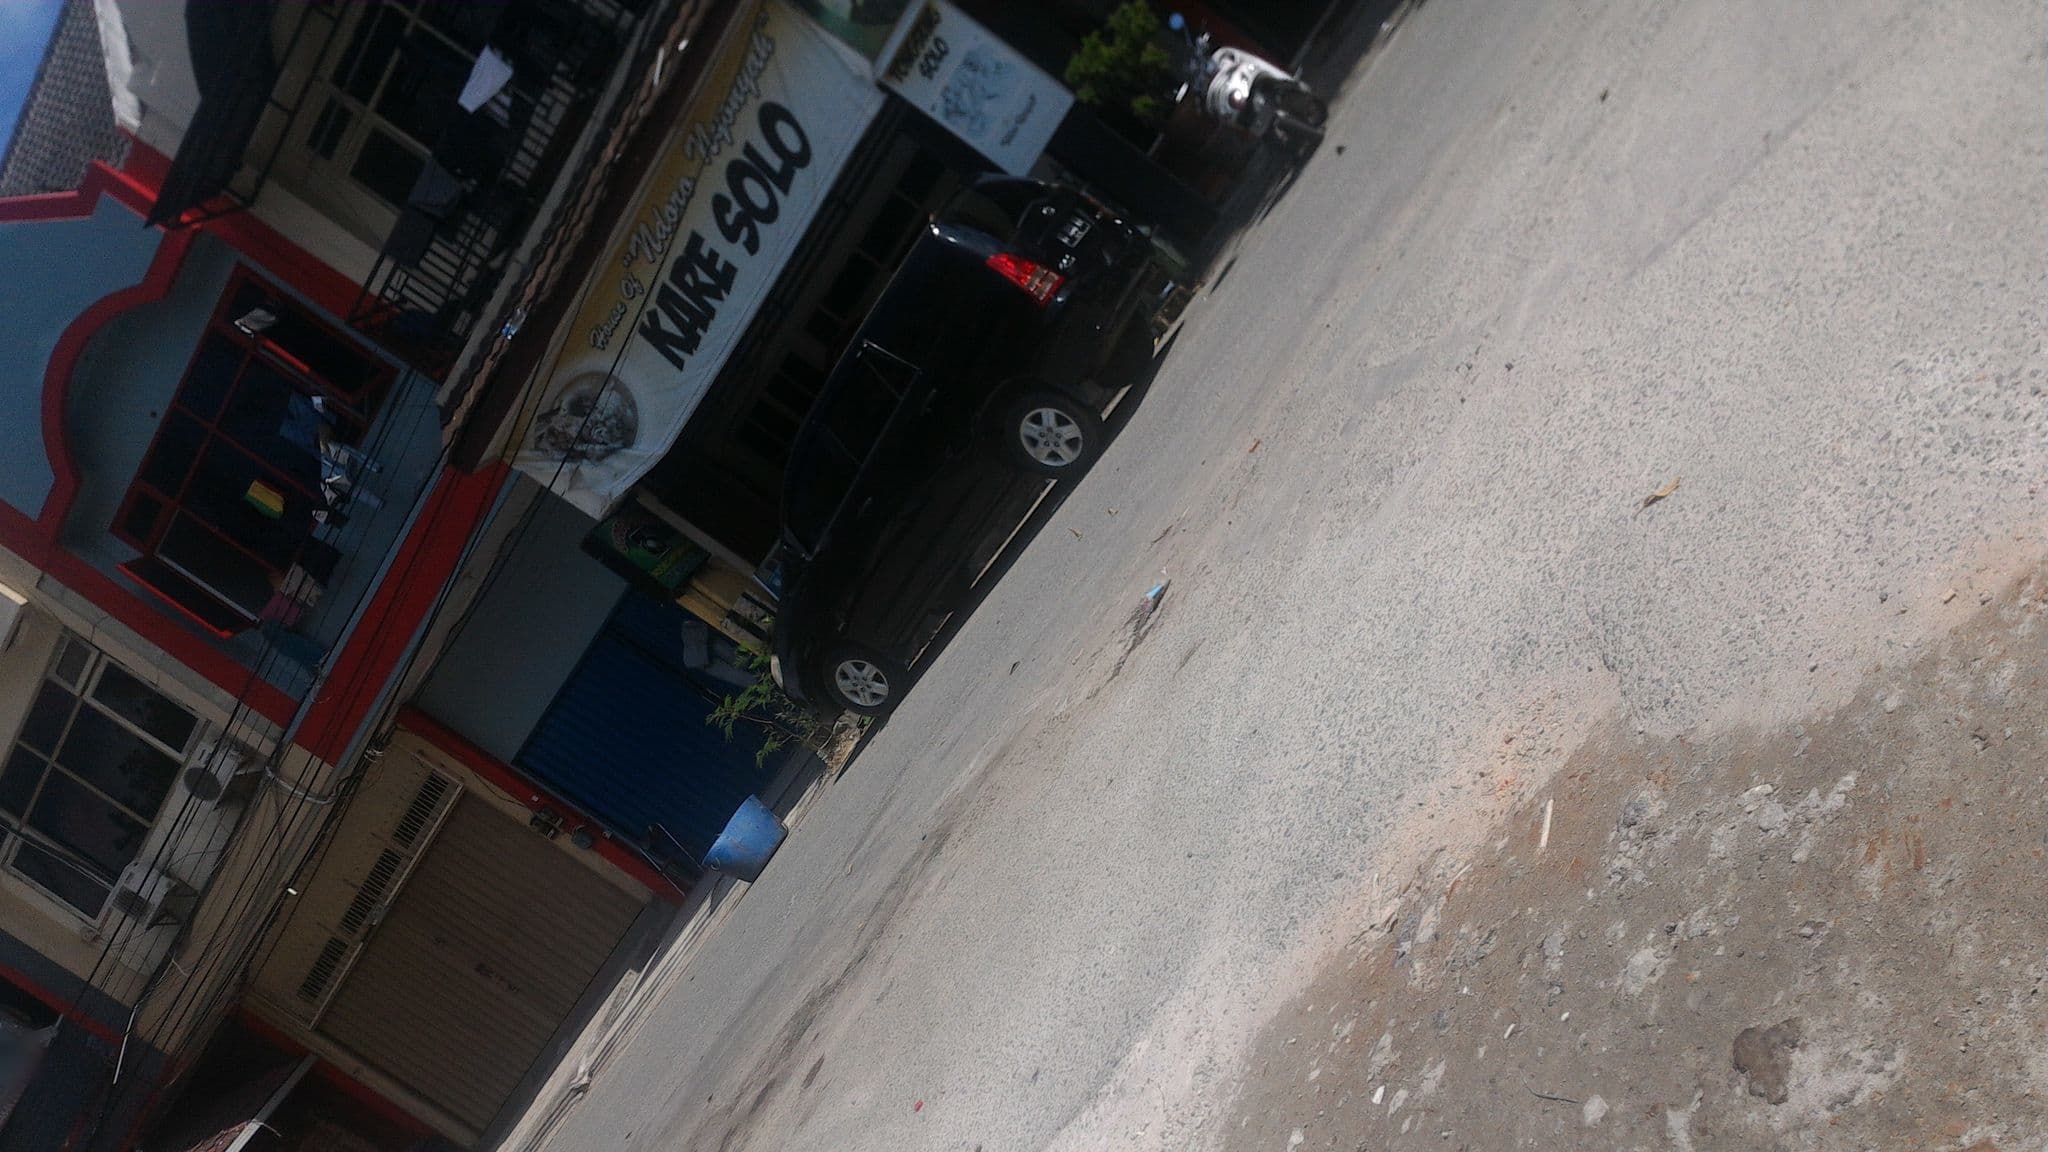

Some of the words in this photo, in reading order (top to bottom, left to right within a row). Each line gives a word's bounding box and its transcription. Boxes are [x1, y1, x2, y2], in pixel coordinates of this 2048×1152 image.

[638, 229, 738, 372] KARE
[712, 101, 812, 257] SOLO
[589, 302, 628, 351] House
